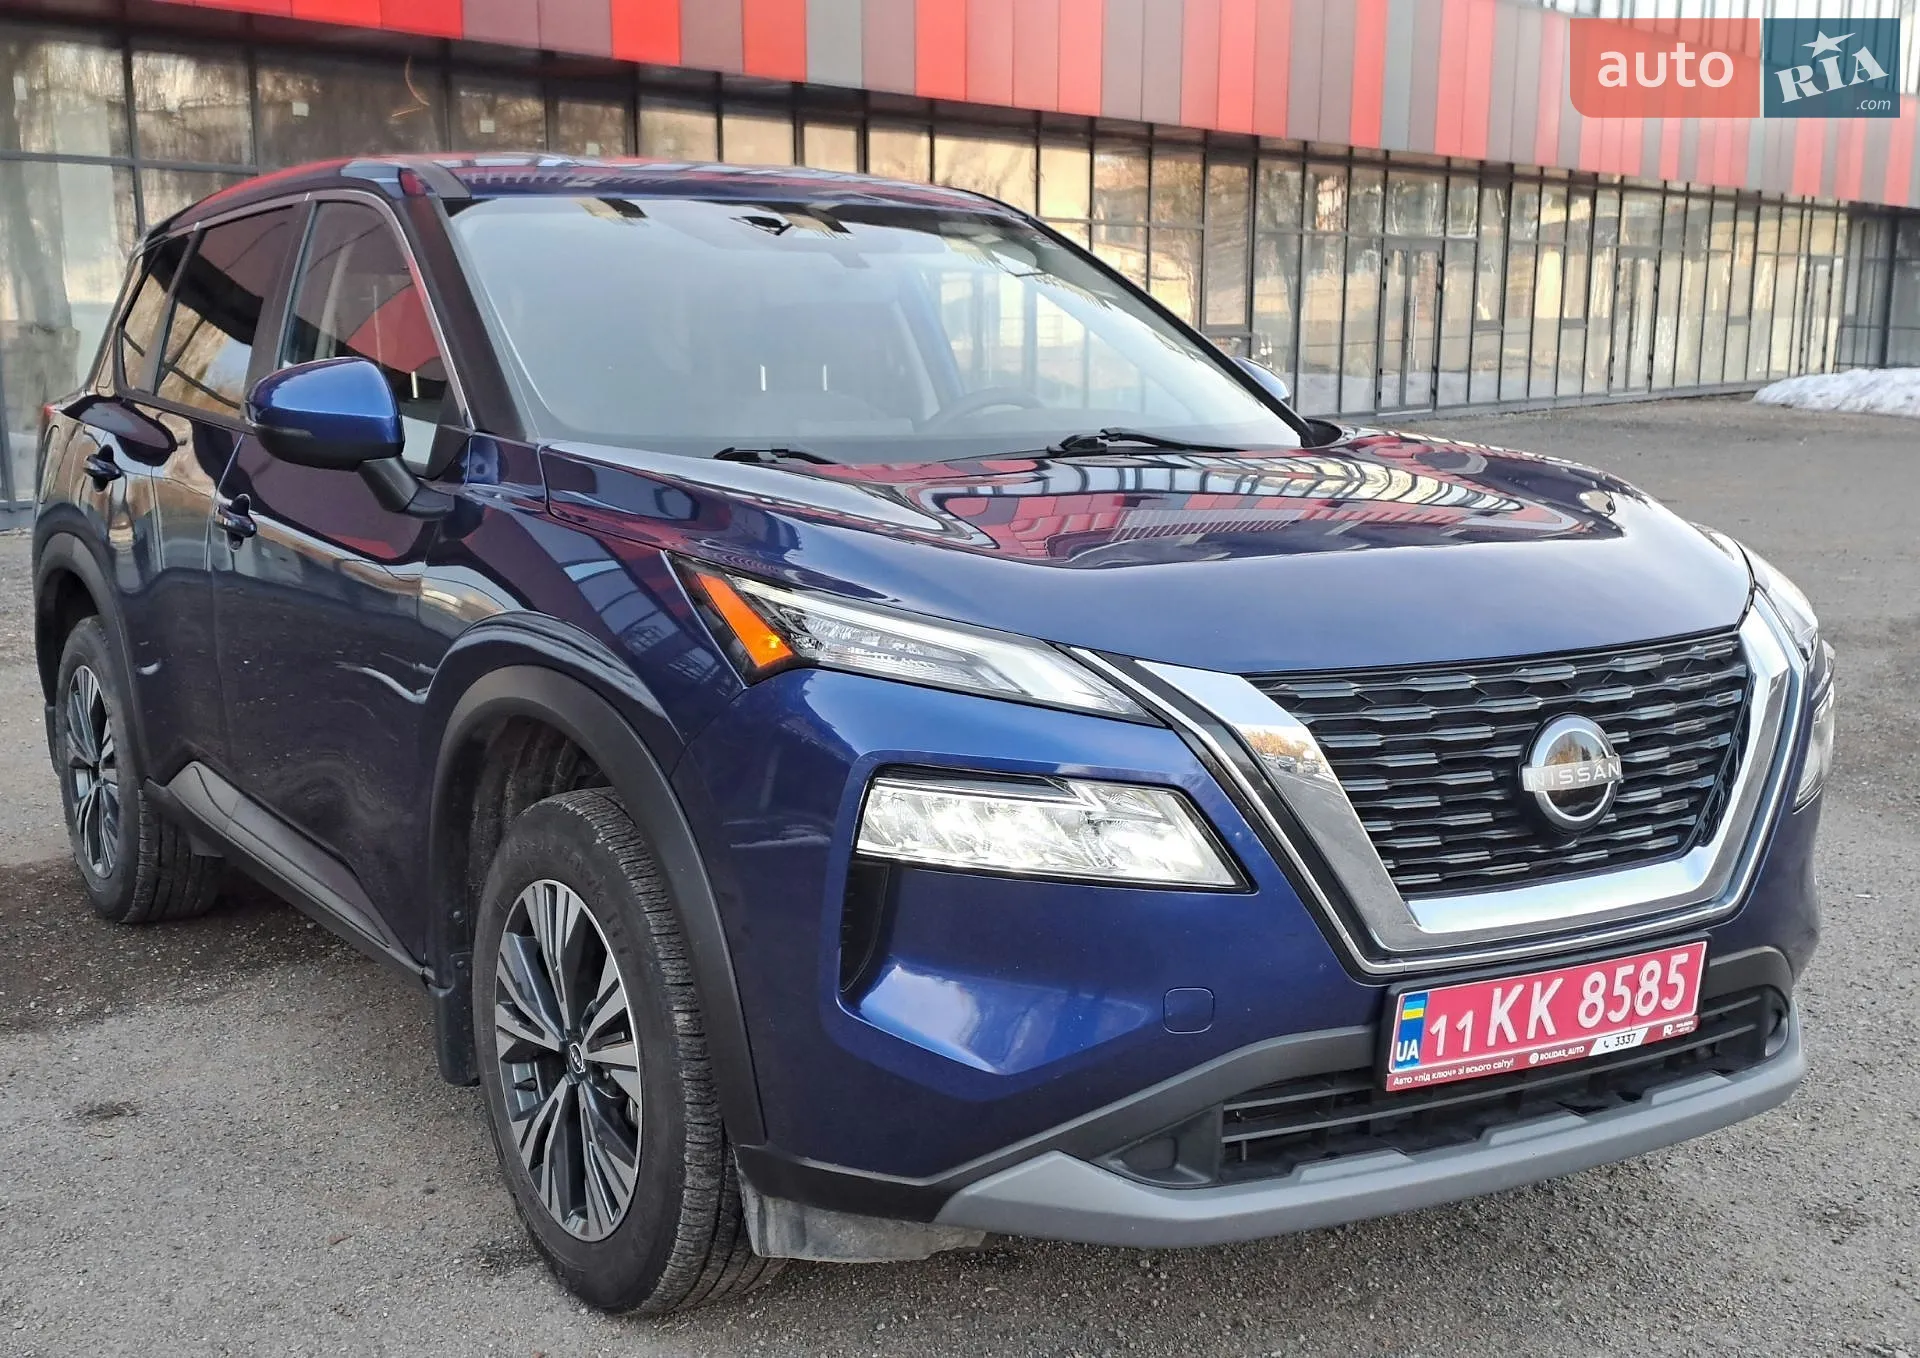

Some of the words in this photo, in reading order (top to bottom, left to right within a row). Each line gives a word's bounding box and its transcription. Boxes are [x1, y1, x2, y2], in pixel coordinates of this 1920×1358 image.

[1527, 760, 1620, 791] NISSAN
[1576, 952, 1690, 1030] 8585
[1396, 1040, 1420, 1062] UA
[1614, 1033, 1637, 1047] 3337
